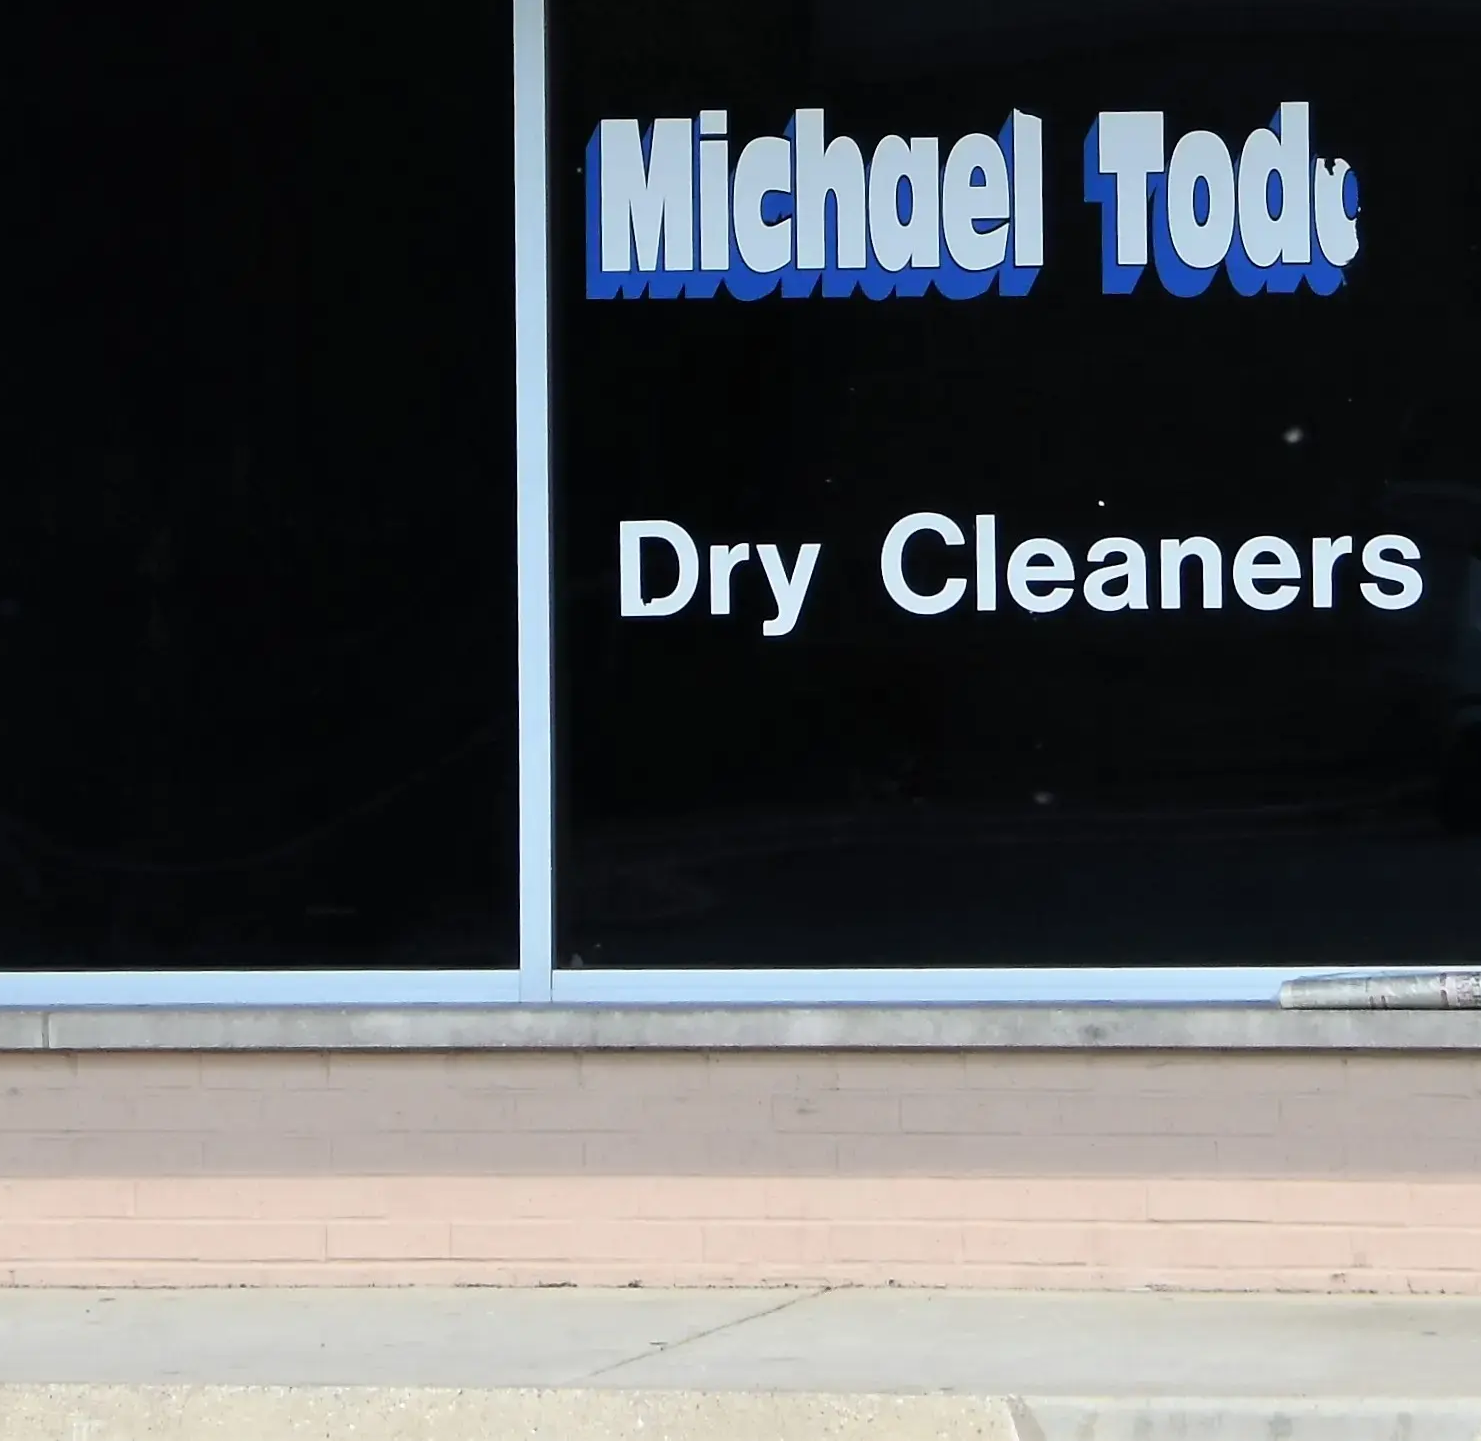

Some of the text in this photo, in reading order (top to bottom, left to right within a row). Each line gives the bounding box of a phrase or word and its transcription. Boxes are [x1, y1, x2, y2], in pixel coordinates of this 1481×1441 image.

[586, 108, 1043, 301] Michael
[619, 511, 1424, 637] Dry Cleaners
